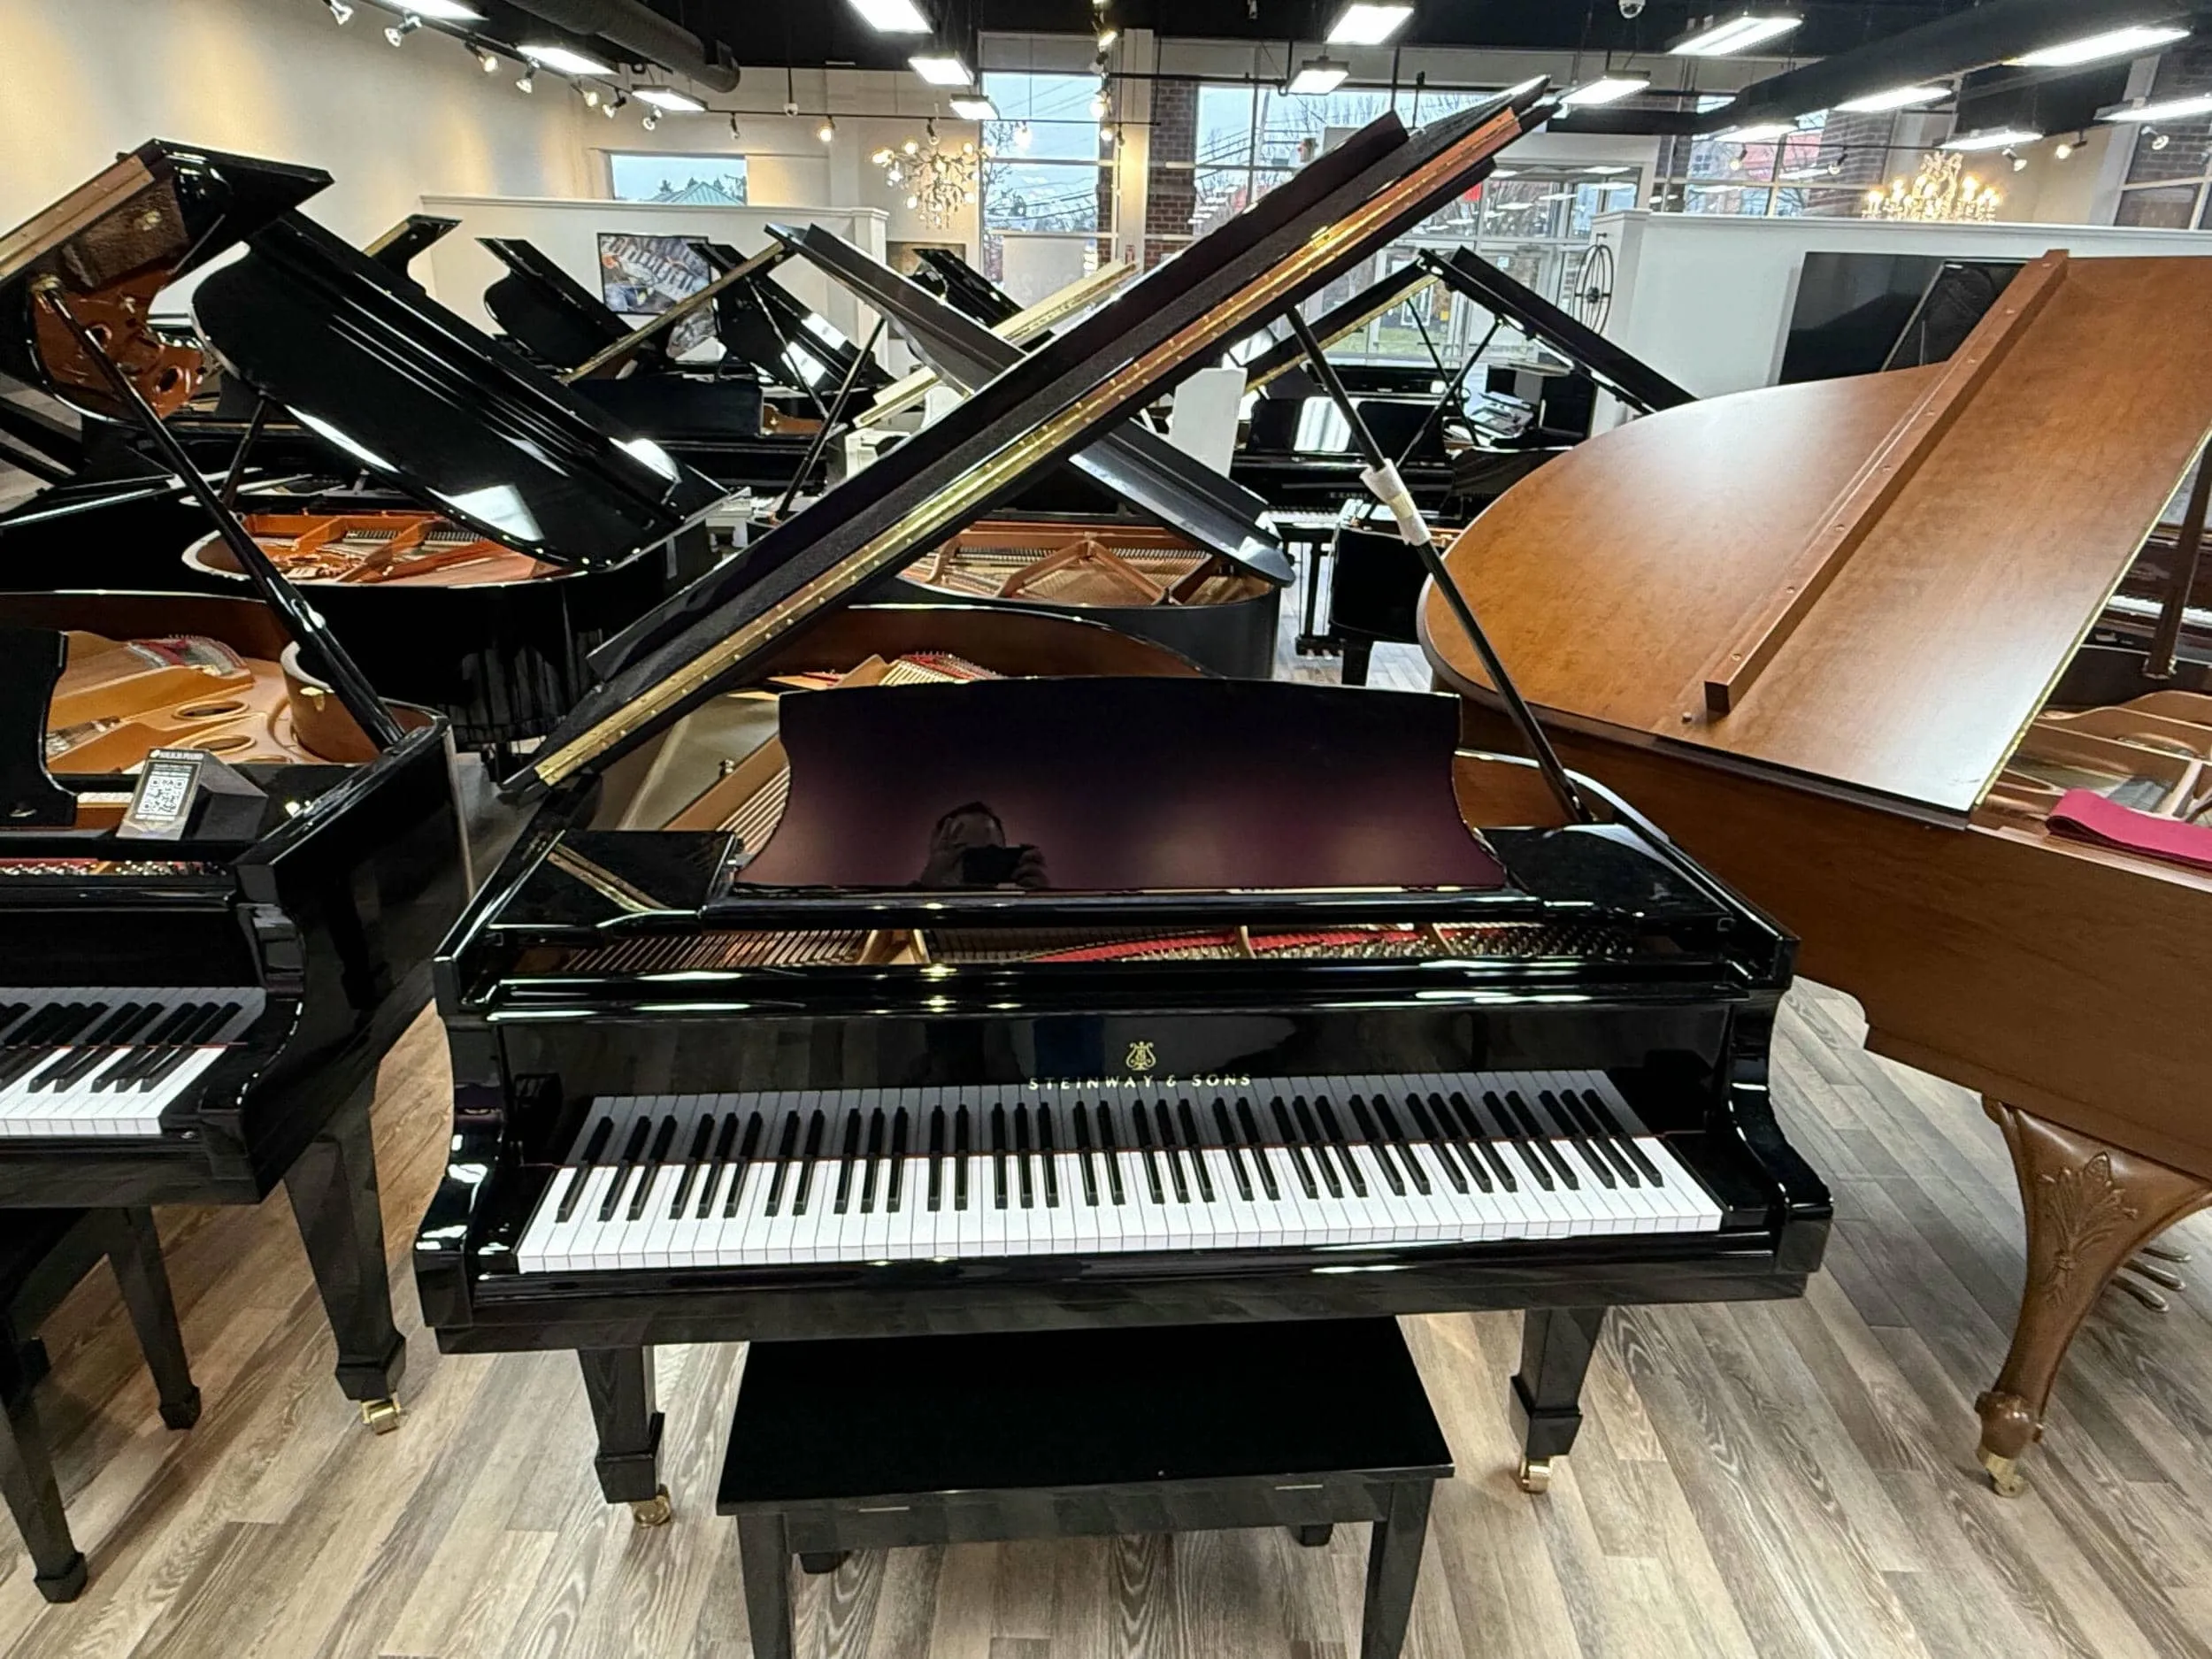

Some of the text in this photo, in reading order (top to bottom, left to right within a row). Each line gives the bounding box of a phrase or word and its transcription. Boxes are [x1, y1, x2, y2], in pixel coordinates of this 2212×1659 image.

[1028, 1072, 1250, 1090] STEINWAY & SONS
